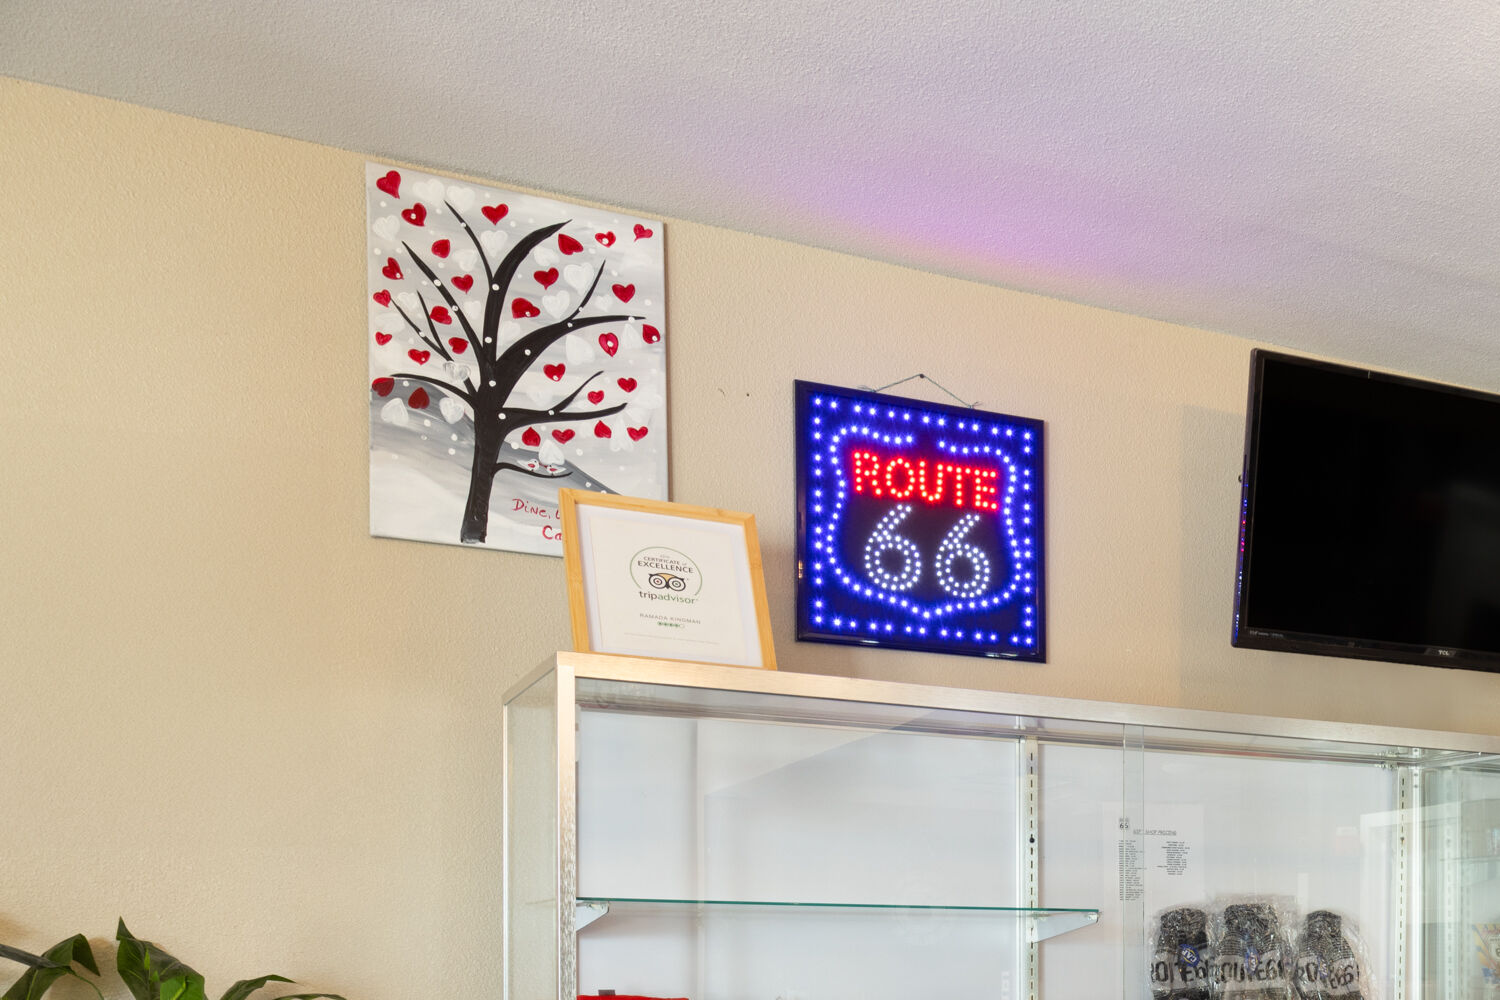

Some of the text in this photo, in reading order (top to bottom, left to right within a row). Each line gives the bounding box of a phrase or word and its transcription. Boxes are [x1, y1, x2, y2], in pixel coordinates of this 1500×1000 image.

[853, 451, 999, 510] ROUTE
[864, 504, 992, 598] 66
[637, 560, 694, 574] EXCELLENCE
[643, 556, 680, 565] CERTIFICATE
[639, 590, 696, 604] tripadvisor
[640, 613, 701, 625] RAMADA KINGMAN
